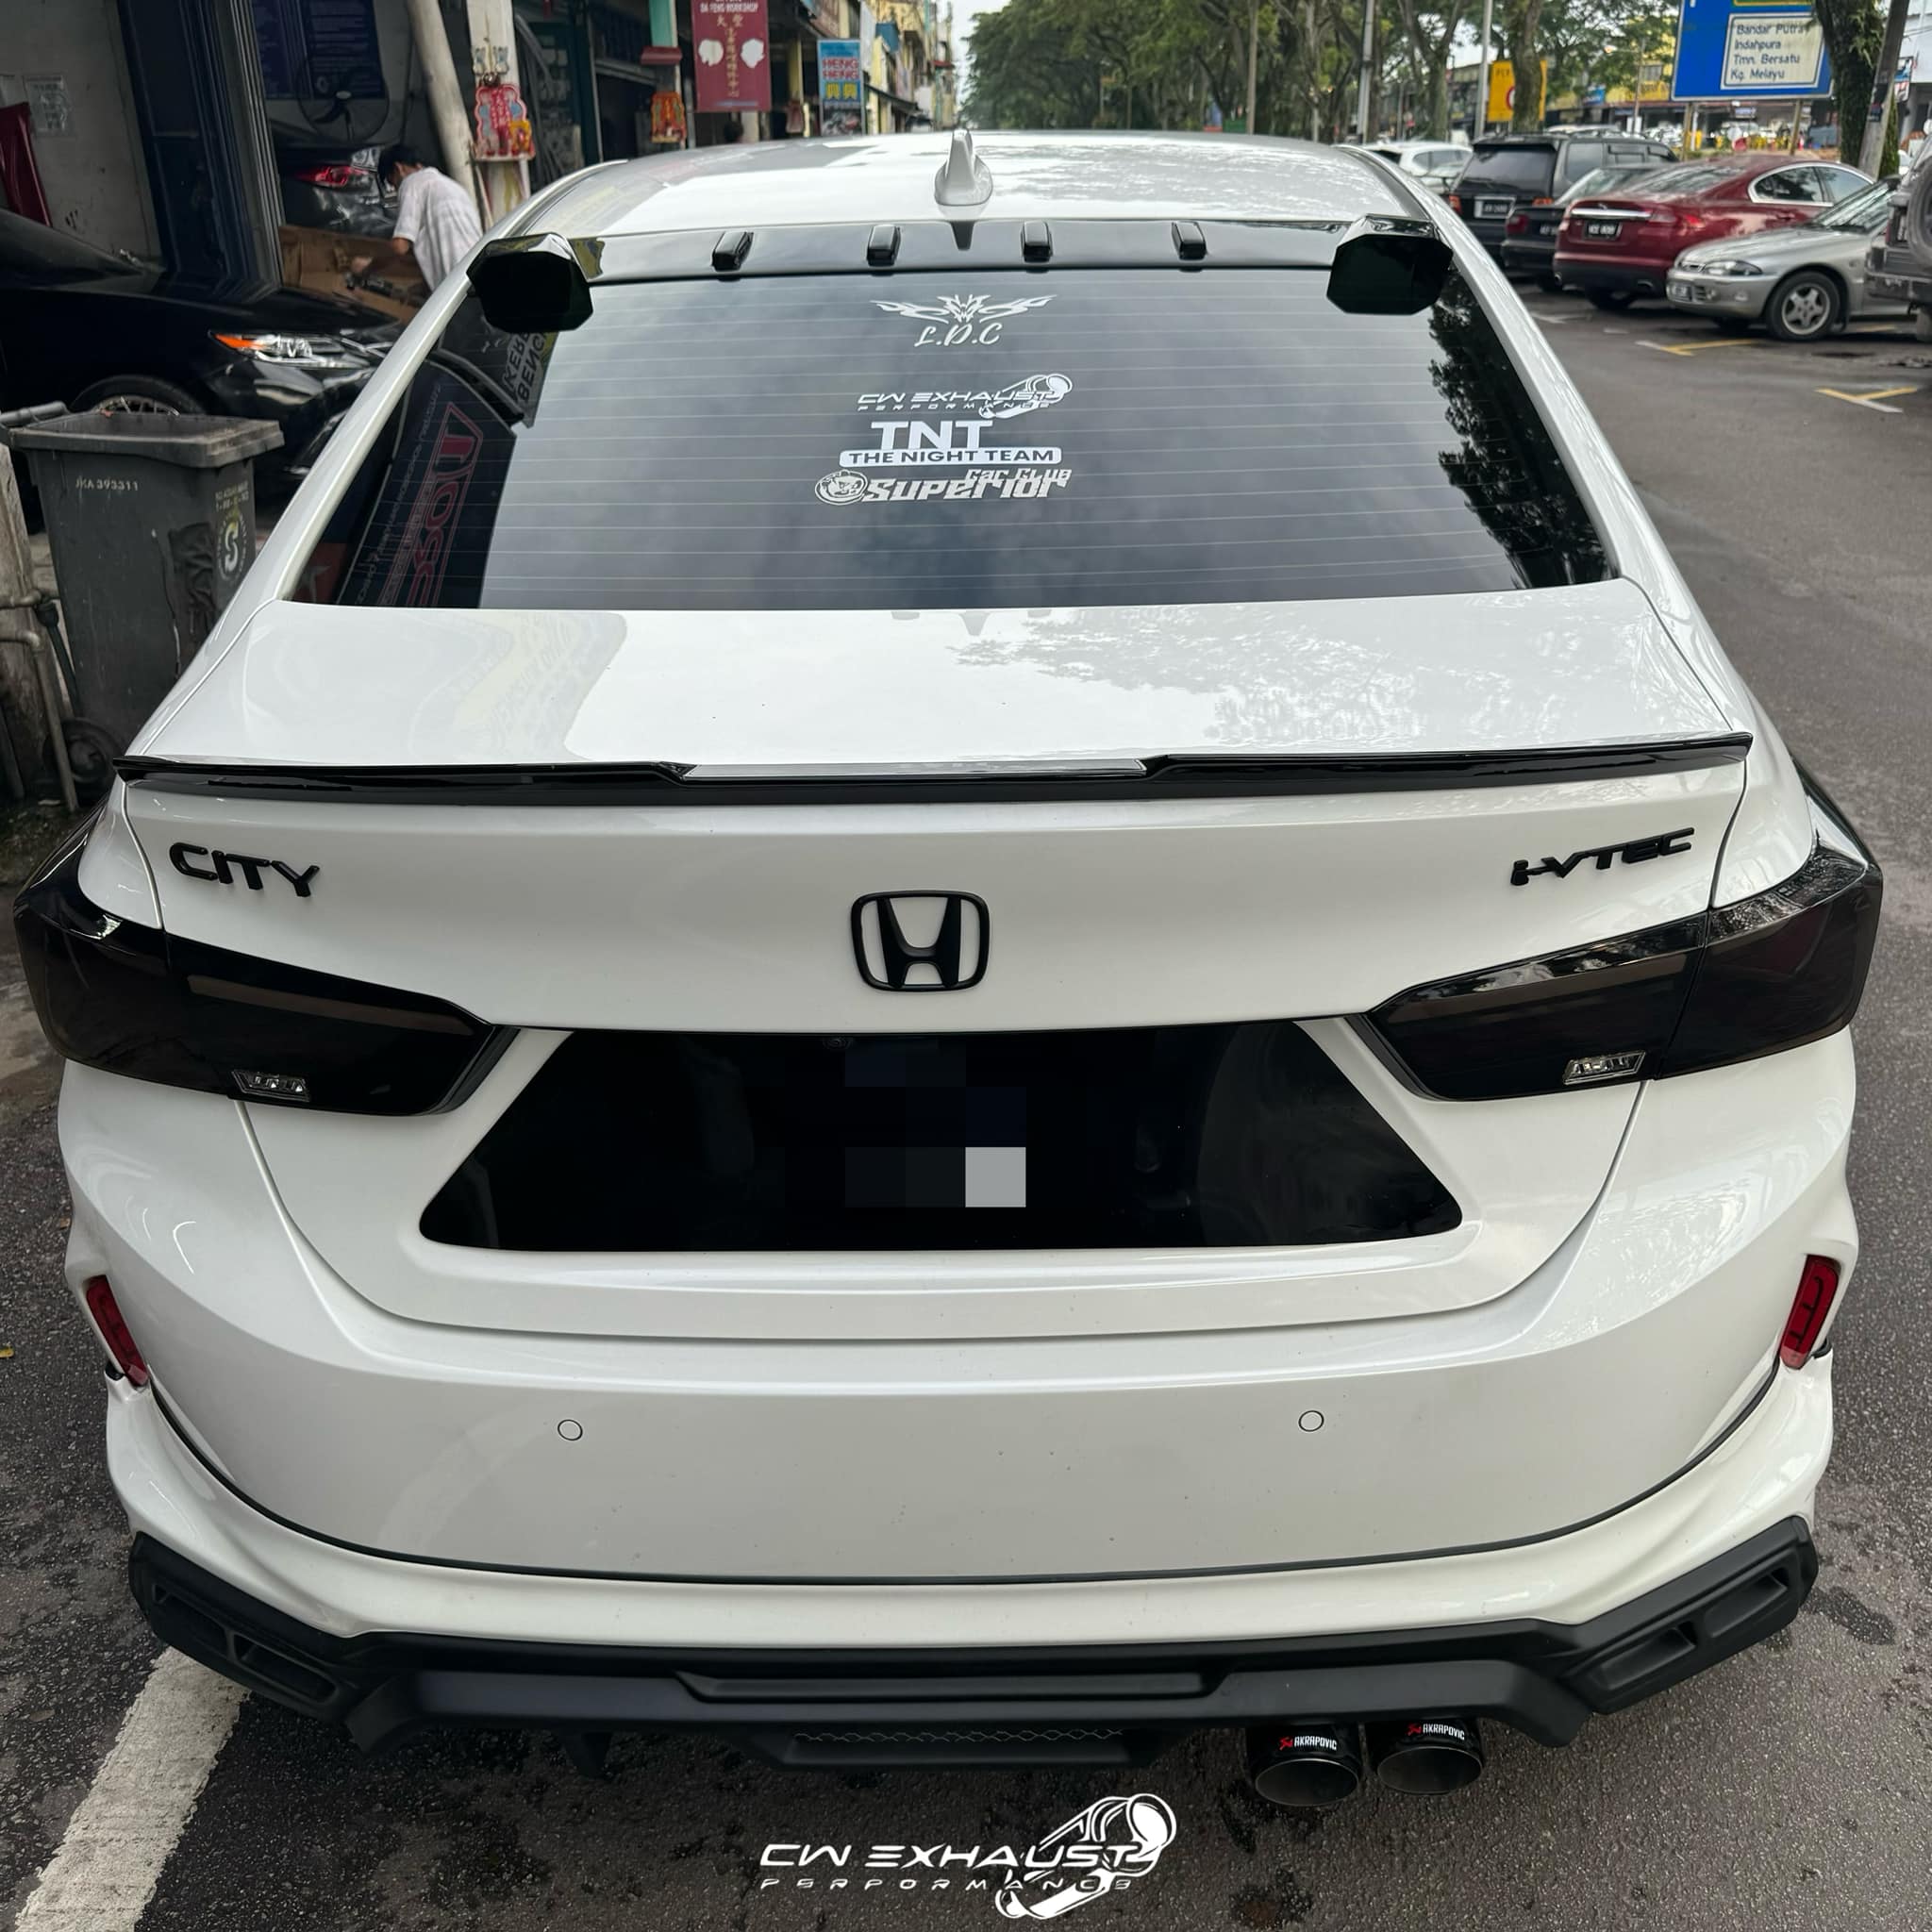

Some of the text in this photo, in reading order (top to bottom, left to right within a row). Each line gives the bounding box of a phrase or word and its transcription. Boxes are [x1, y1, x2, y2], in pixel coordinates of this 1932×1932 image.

[1736, 24, 1771, 36] Bandar
[1734, 39, 1781, 52] Indahpura
[822, 58, 859, 69] HENG
[1760, 53, 1800, 64] Bersatu
[1750, 68, 1785, 81] Melayu
[858, 390, 1055, 404] CW EXHAUST
[871, 421, 993, 450] TNT
[849, 450, 1054, 464] THE NIGHT TEAM
[169, 841, 321, 897] CITY
[1423, 1723, 1465, 1740] AKRAPOVIC
[1293, 1735, 1337, 1751] AKRAPOVIC
